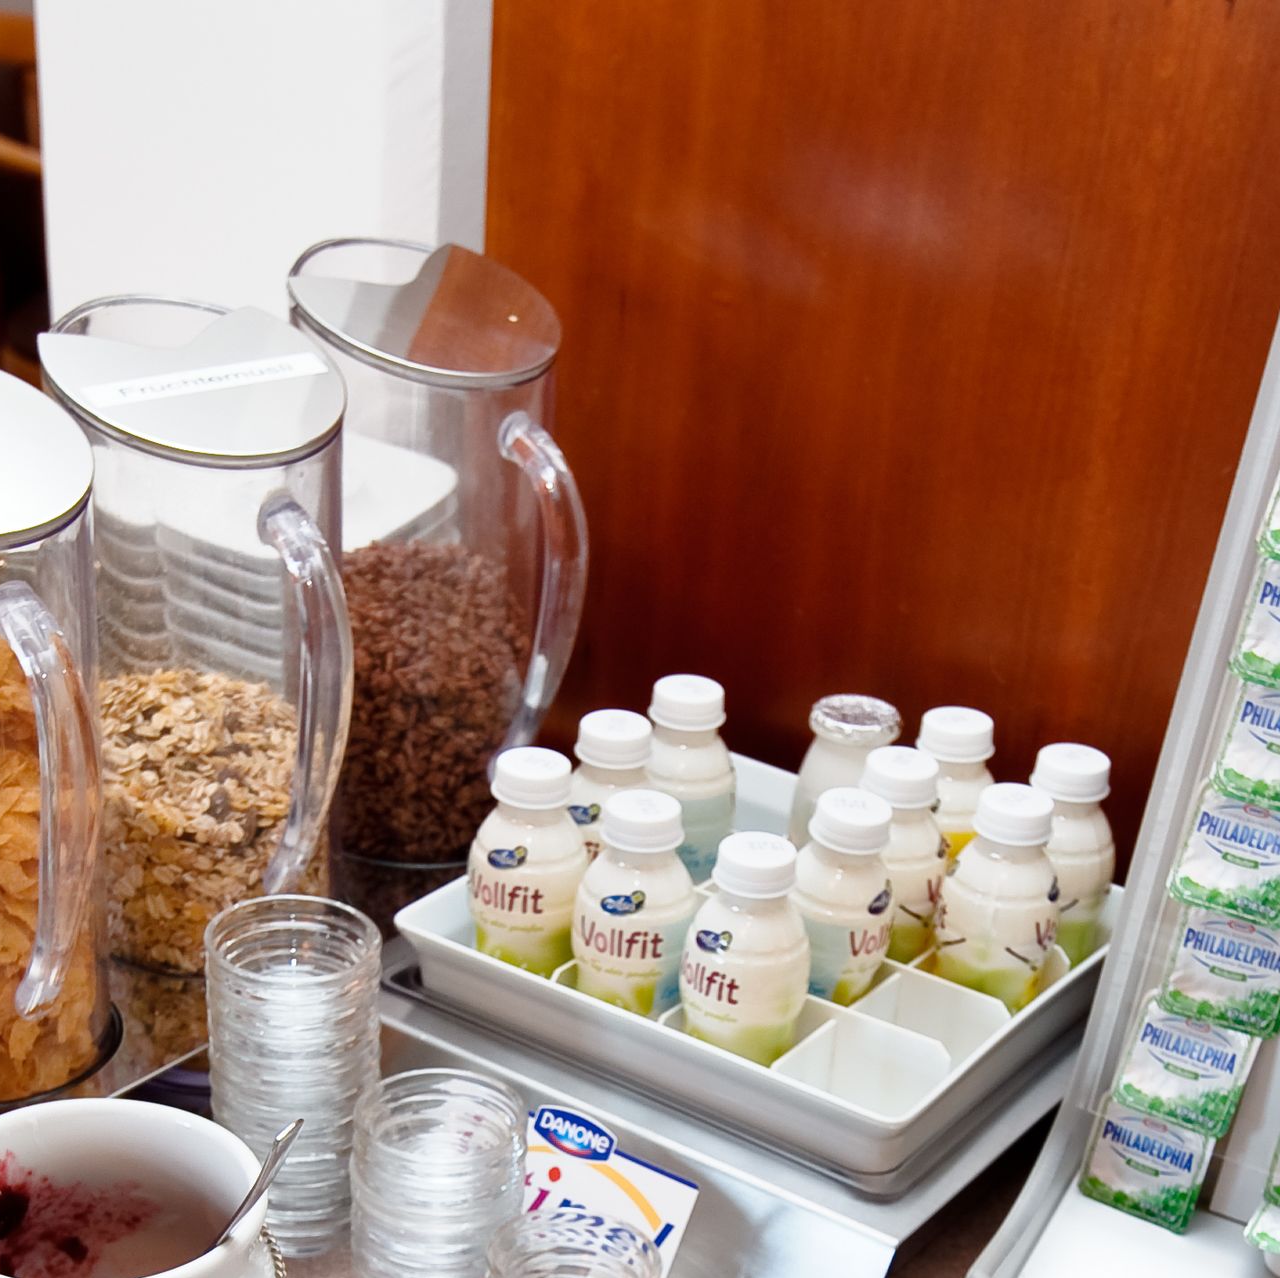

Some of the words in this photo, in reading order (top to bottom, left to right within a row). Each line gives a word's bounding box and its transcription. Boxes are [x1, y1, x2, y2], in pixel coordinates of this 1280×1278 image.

[471, 867, 544, 915] Vollfit
[581, 915, 664, 960] Vollfit
[1140, 1022, 1236, 1074] PHILADELPHIA
[539, 1111, 610, 1154] DANONE
[1103, 1119, 1193, 1173] PHILADELPHIA
